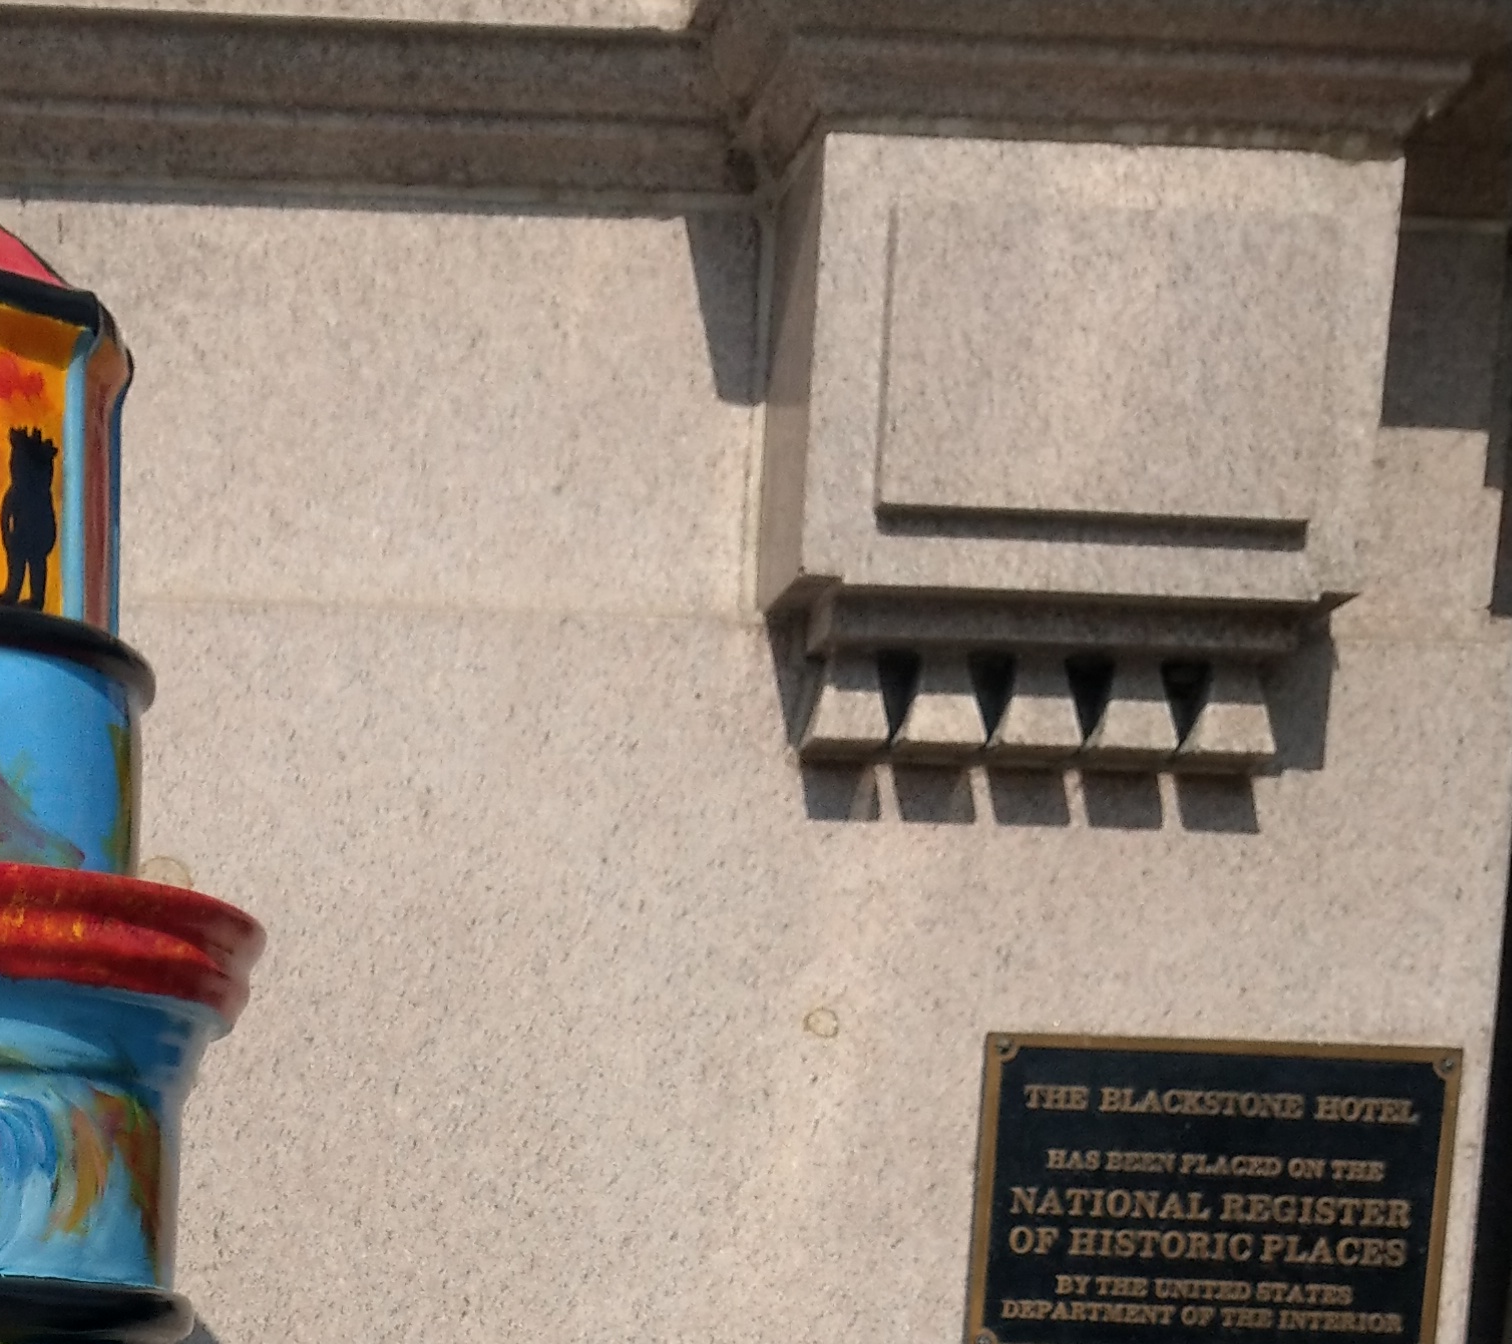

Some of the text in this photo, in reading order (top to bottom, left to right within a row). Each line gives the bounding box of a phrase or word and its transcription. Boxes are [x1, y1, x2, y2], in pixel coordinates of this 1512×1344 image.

[1023, 1084, 1420, 1124] THE BLACKSTONE HOTEL
[1046, 1148, 1386, 1182] HAS BEEN PLACED ON THE
[1009, 1186, 1412, 1229] NATIONAL REGISTER
[1008, 1225, 1407, 1267] OF HISTORIC PLACES
[1055, 1274, 1353, 1306] BY THE UNITED STATES
[1001, 1300, 1403, 1334] DEPARTMENT OF THE INTERIOR
